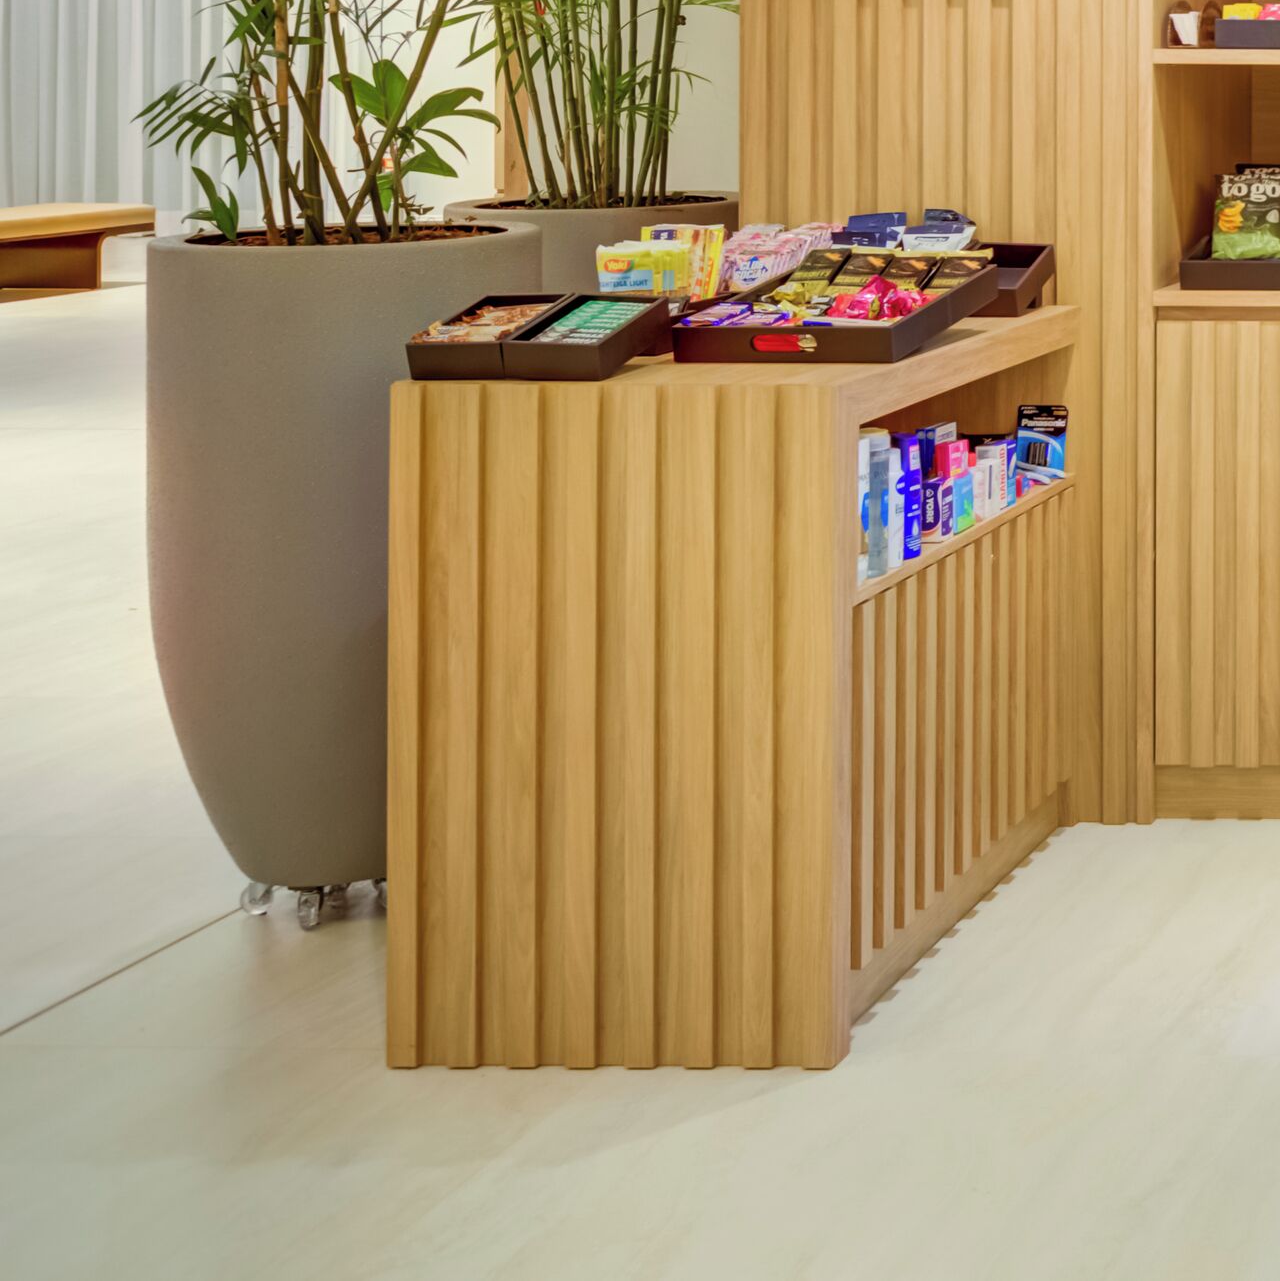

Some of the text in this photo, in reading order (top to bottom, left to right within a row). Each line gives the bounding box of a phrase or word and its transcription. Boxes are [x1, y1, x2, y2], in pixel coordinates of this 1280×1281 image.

[1221, 181, 1249, 198] to
[1021, 418, 1067, 427] Panasonic
[925, 498, 935, 524] YORK
